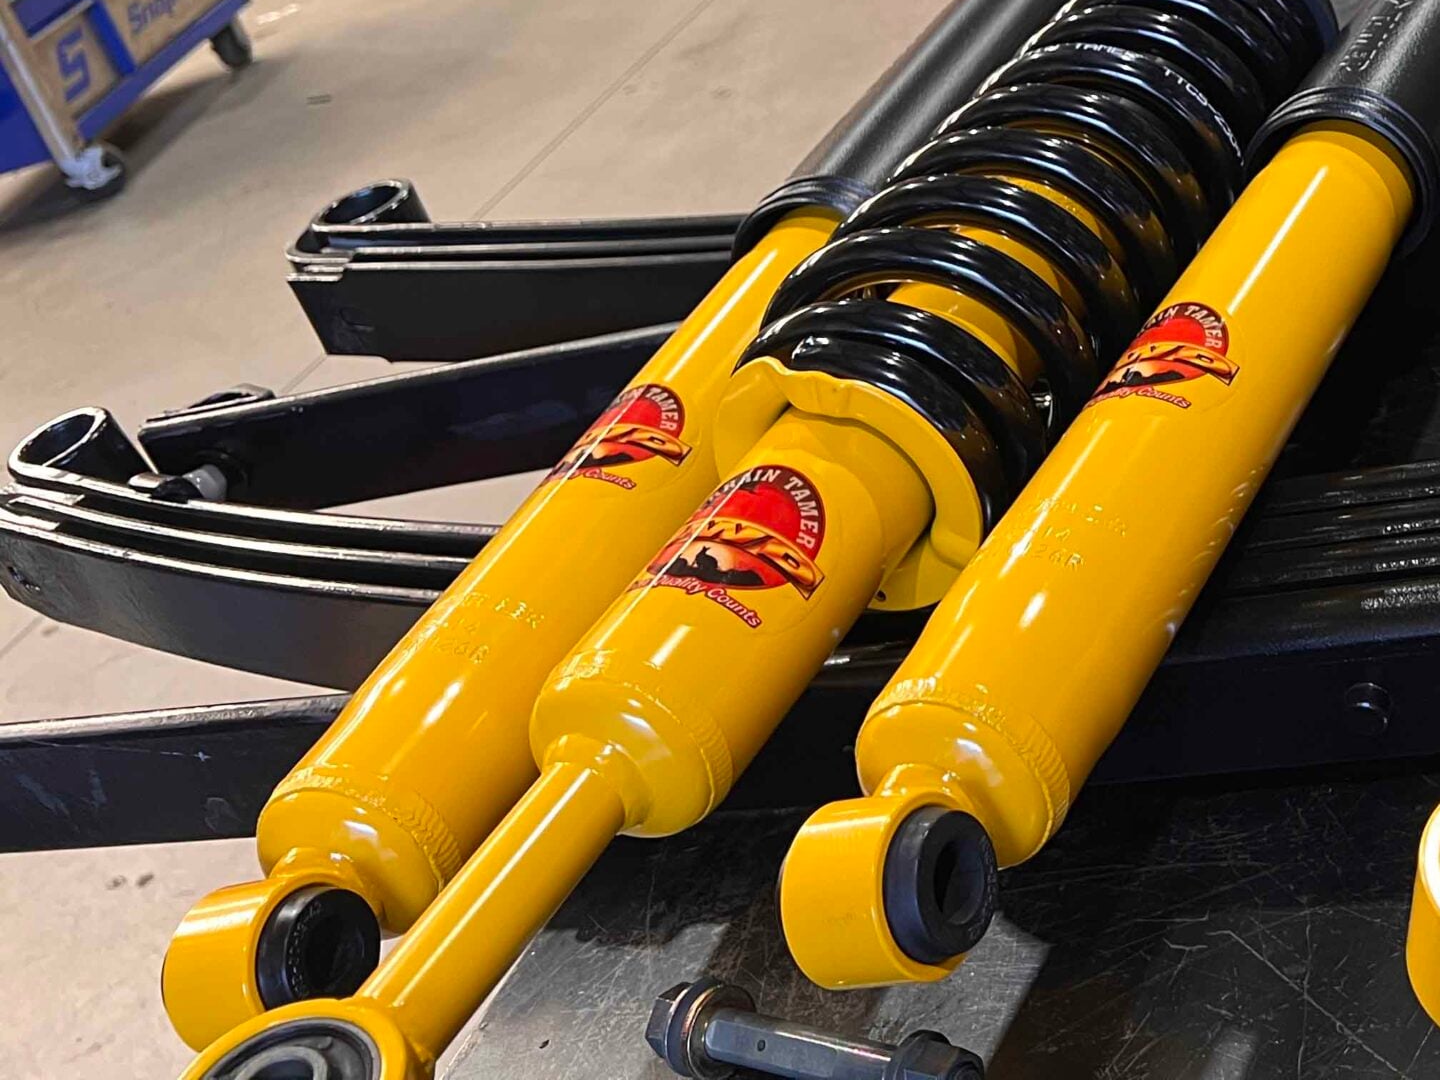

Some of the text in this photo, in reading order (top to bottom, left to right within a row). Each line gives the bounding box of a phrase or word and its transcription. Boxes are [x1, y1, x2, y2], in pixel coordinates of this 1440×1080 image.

[1183, 304, 1223, 349] TAMER
[645, 386, 679, 431] TAMER
[1136, 386, 1193, 410] Counts
[583, 468, 638, 490] Counts
[785, 476, 819, 551] TAMER
[706, 586, 762, 629] Counts
